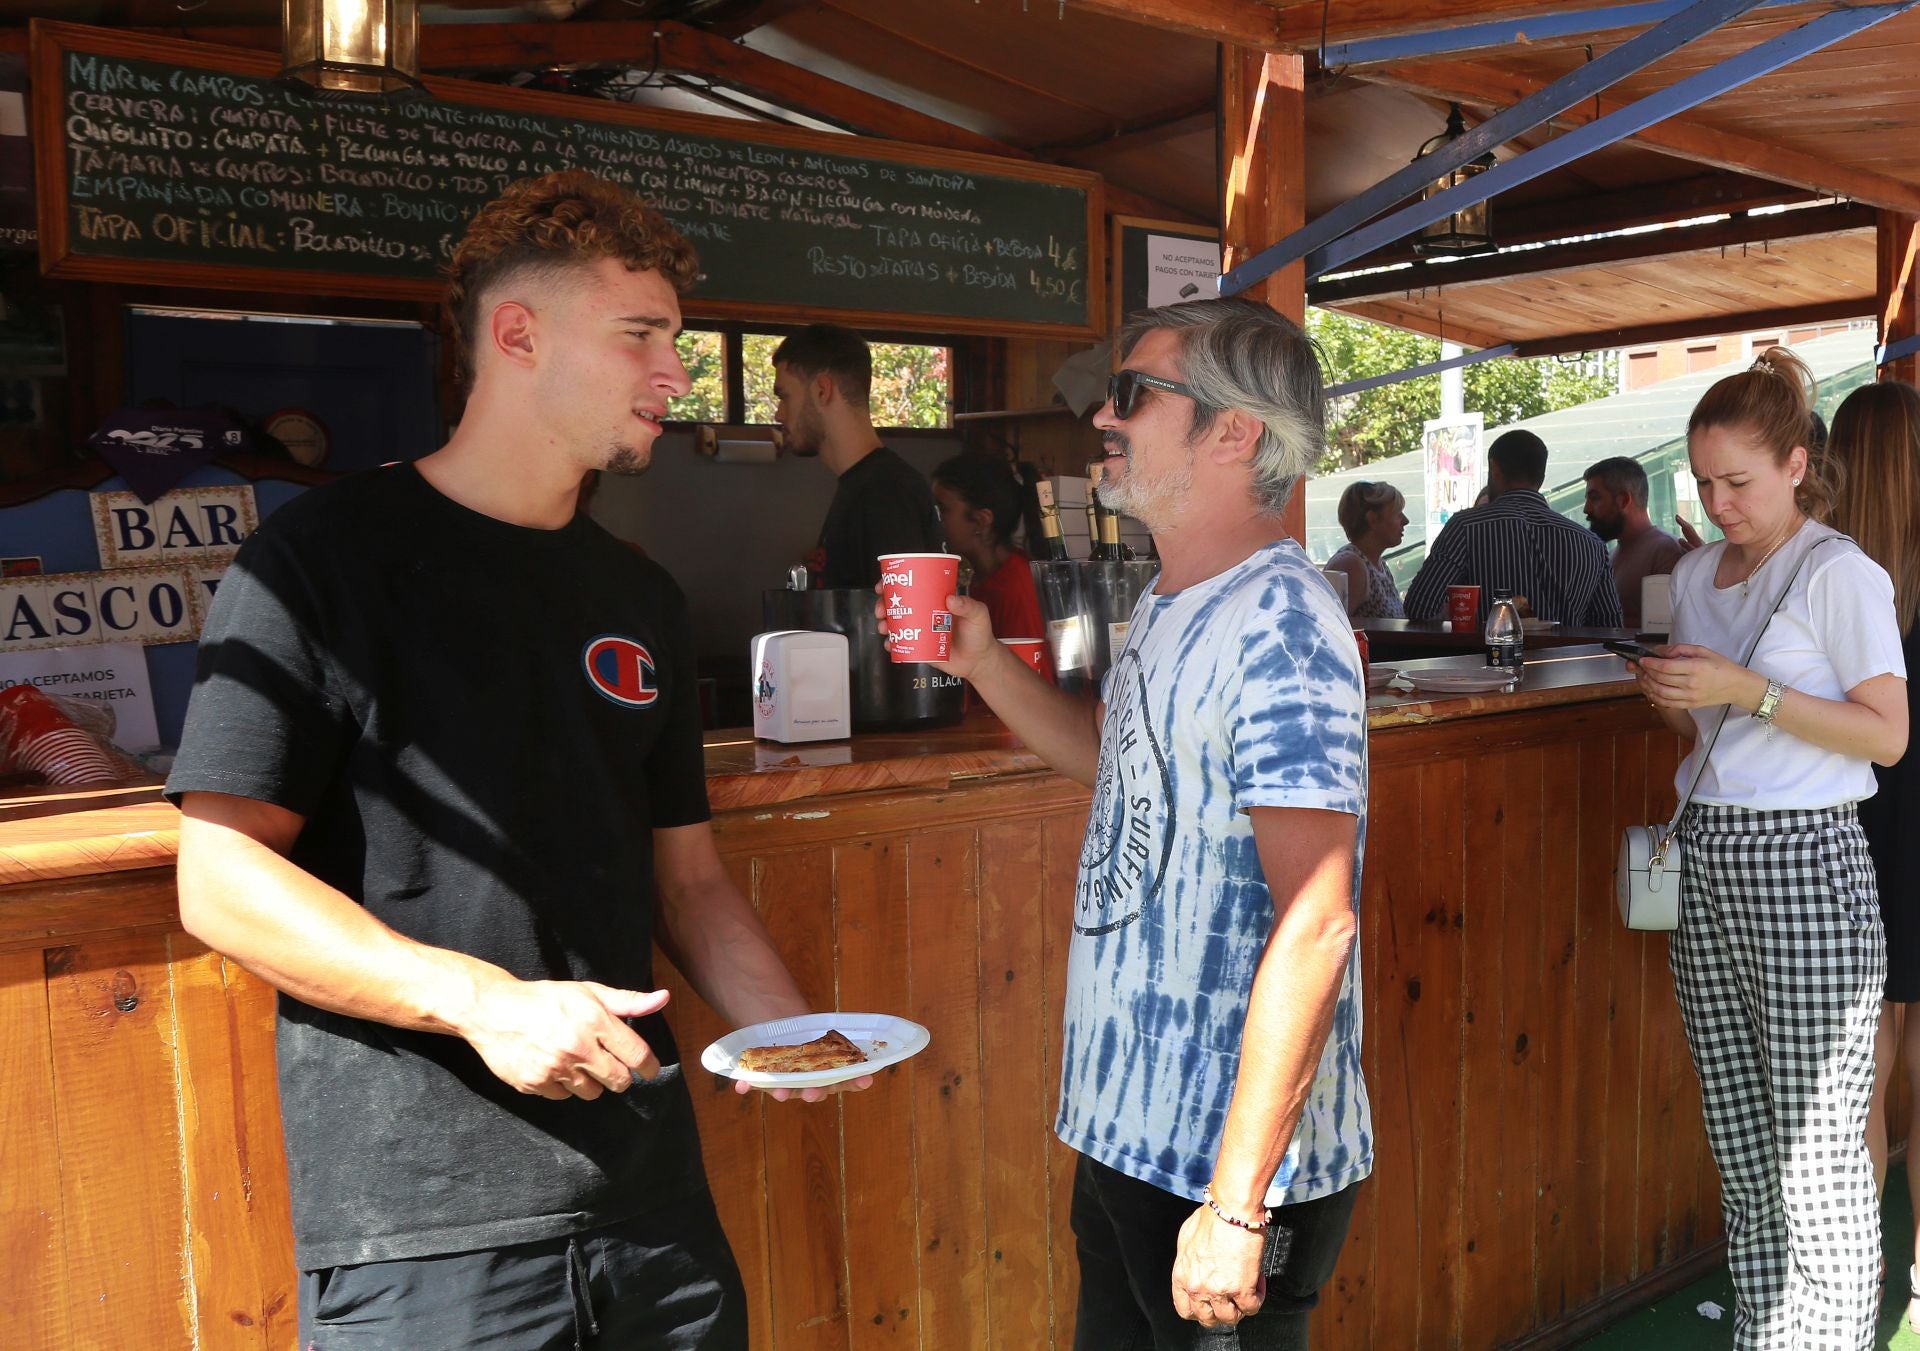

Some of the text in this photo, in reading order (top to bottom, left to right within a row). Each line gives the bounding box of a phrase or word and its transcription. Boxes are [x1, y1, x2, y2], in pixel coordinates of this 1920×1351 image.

[69, 53, 138, 93] MAR
[531, 139, 548, 154] A
[555, 141, 579, 159] LA
[71, 203, 143, 241] TAPA
[868, 223, 925, 249] TAPA
[1162, 254, 1215, 267] NO ACEPTAMOS
[1155, 265, 1178, 276] PAGOS
[1179, 268, 1194, 277] CON
[111, 504, 245, 552] BAR
[21, 669, 116, 688] ACEPTAMOS
[912, 677, 927, 690] 28
